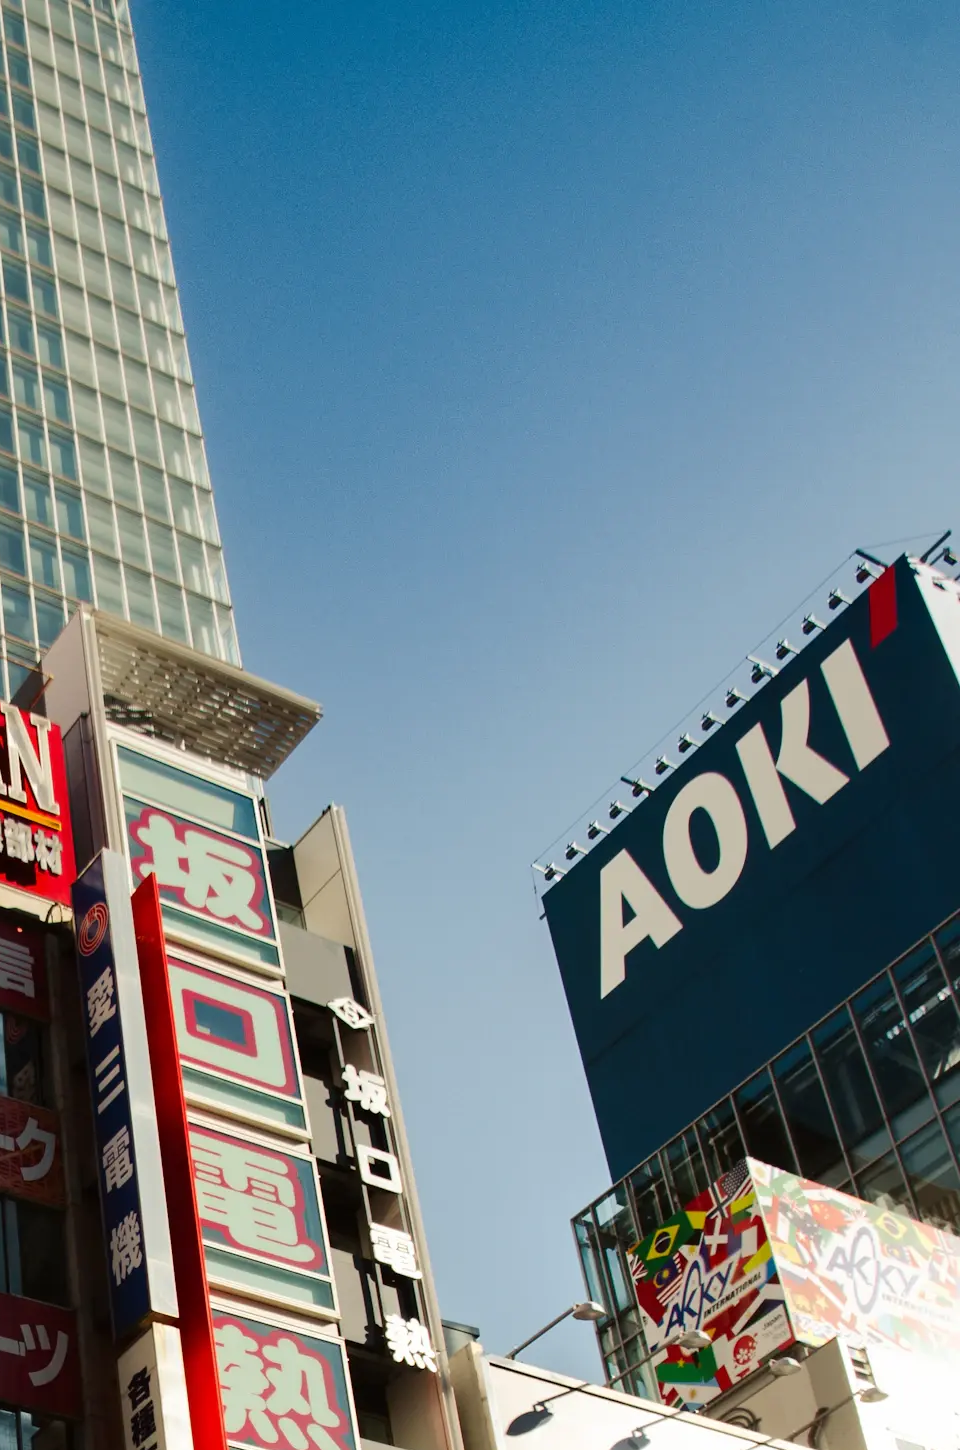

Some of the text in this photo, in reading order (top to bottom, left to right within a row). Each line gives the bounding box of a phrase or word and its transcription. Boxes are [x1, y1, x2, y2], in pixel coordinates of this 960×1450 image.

[600, 637, 891, 1000] AOKI
[86, 966, 143, 1287] 愛三電機
[342, 1063, 440, 1374] 坂口電熱
